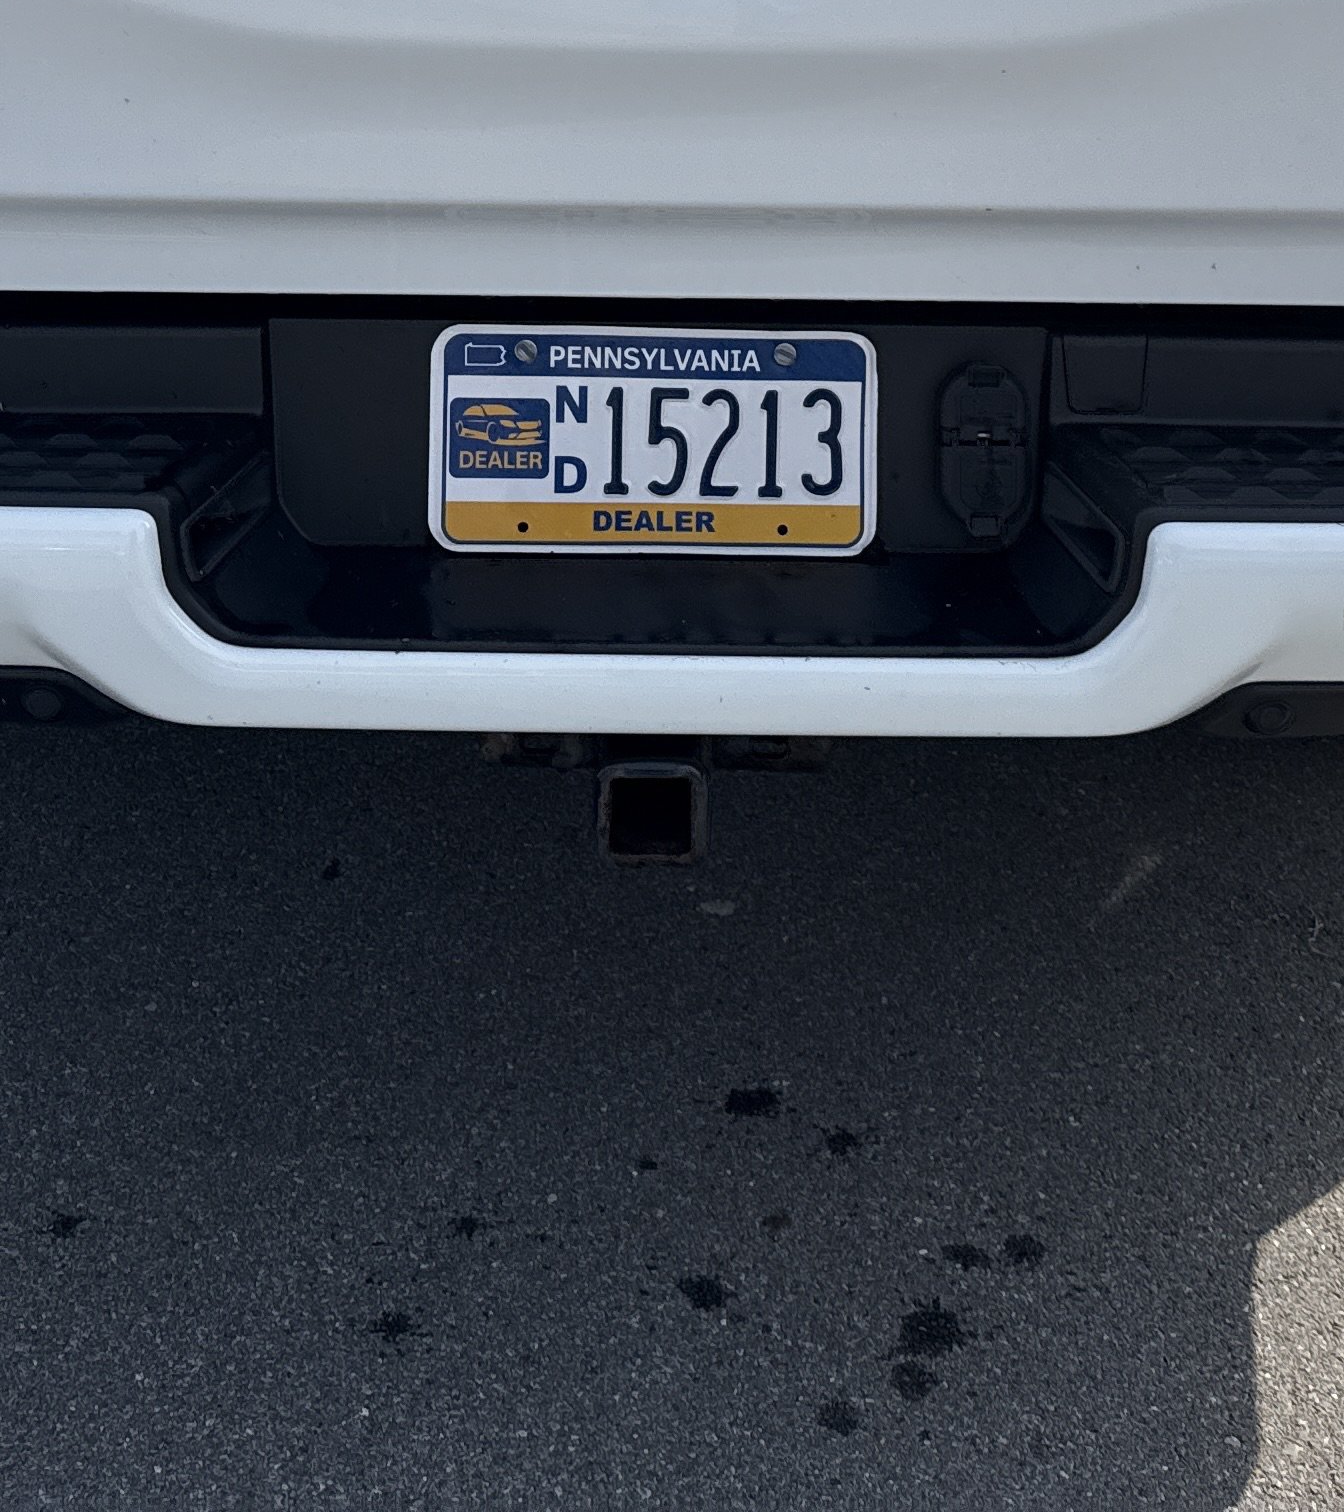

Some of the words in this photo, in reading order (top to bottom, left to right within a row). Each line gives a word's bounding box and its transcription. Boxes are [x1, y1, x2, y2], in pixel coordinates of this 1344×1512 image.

[549, 345, 761, 372] PENNSYLVANIA
[603, 386, 844, 498] 15213
[458, 450, 543, 469] DEALER
[592, 509, 716, 533] DEALER
